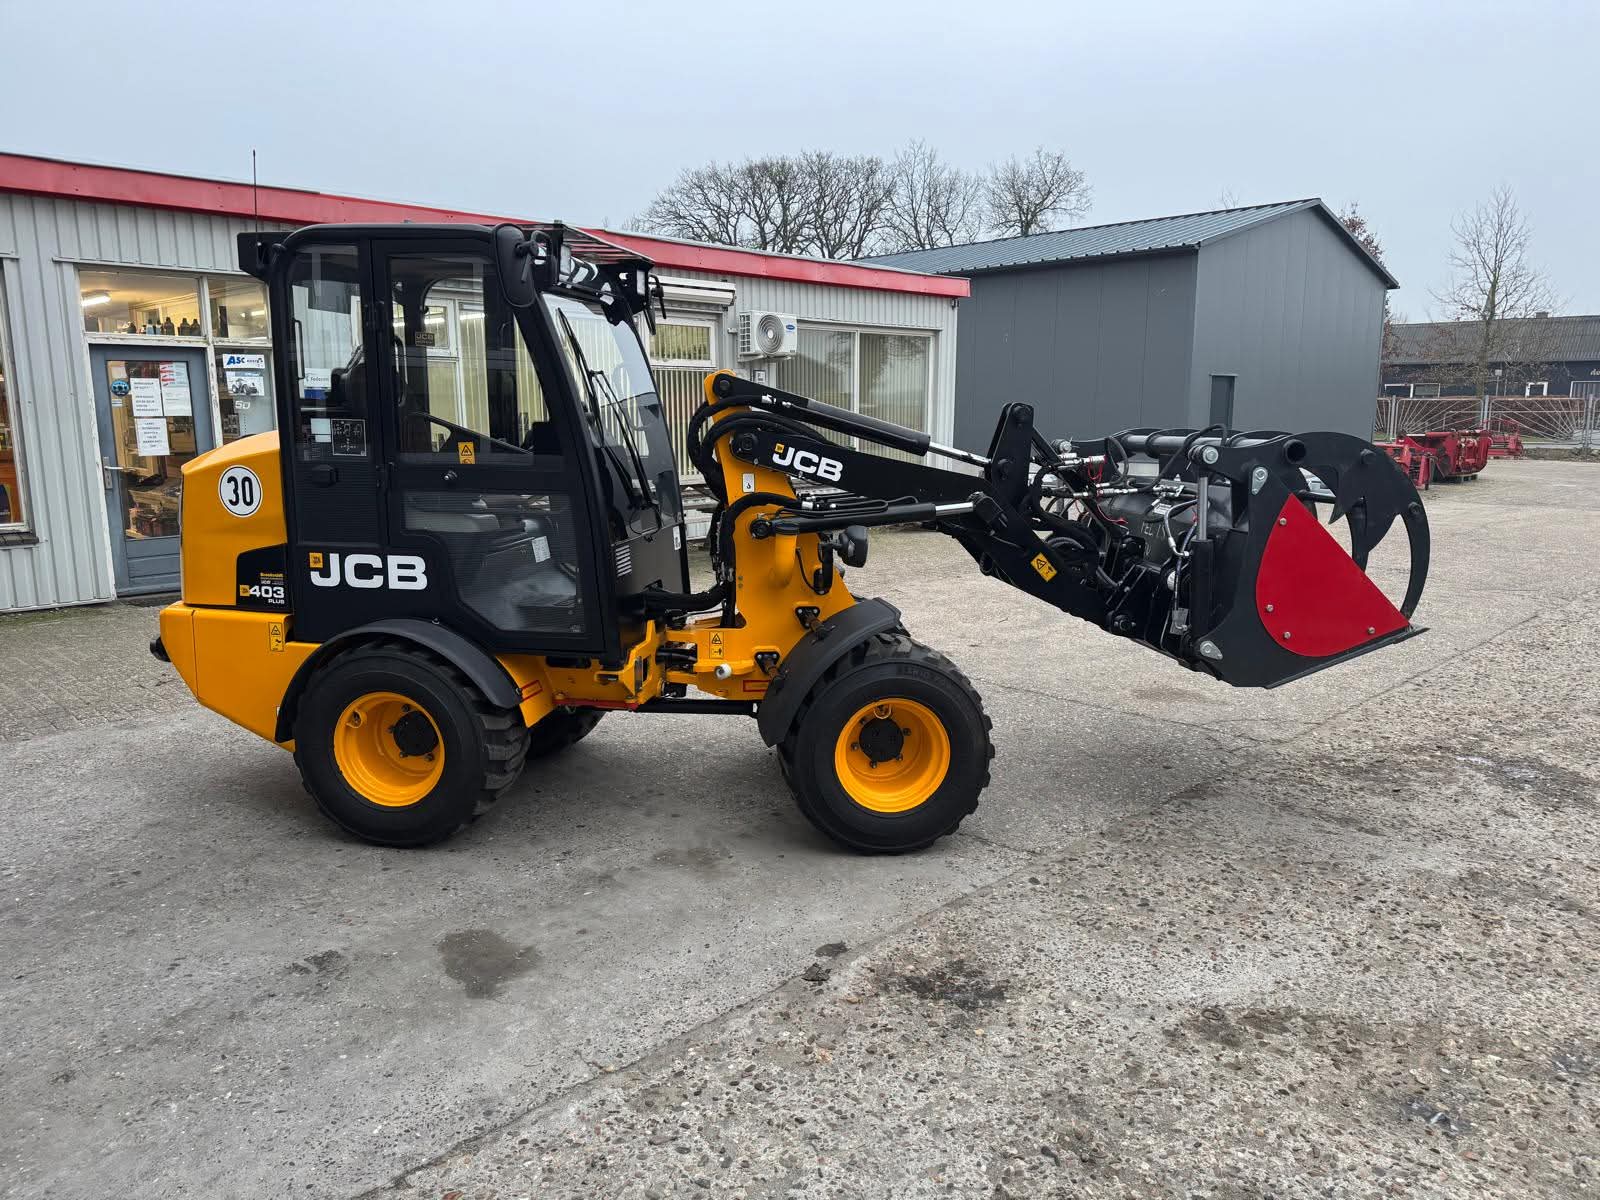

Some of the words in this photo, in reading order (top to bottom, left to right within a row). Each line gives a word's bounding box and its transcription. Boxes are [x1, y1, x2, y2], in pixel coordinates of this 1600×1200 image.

[227, 356, 246, 365] ASC
[772, 446, 843, 482] JCB
[226, 475, 254, 507] 30
[309, 553, 428, 590] JCB
[250, 585, 285, 599] 403
